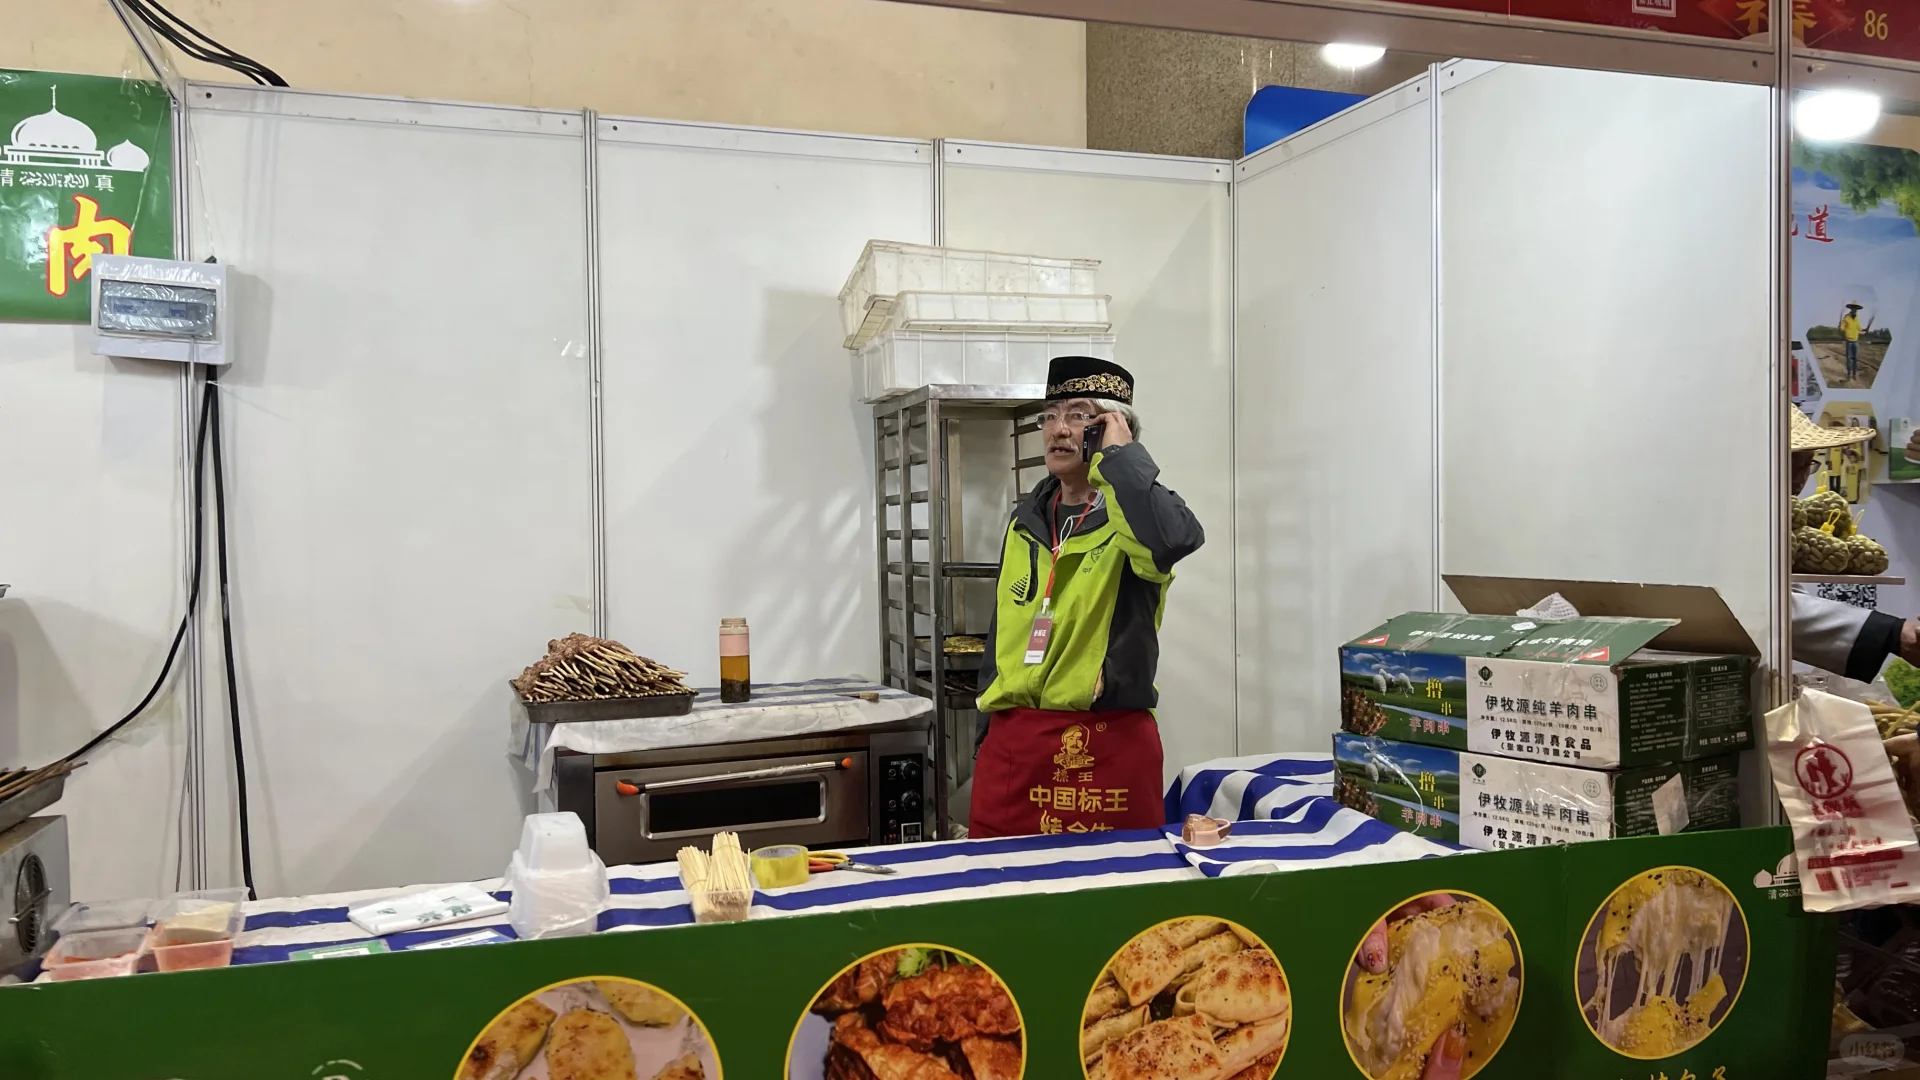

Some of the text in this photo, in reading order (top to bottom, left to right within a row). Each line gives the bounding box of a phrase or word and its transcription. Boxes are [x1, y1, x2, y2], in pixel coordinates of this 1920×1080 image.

[1864, 9, 1889, 41] 86
[95, 174, 115, 193] 真
[47, 194, 132, 297] 肉
[1485, 694, 1598, 721] 伊牧源纯羊肉串
[1409, 716, 1450, 735] 羊肉串
[1491, 728, 1592, 751] 伊牧源清真食品
[1029, 784, 1129, 813] 中国标王
[1478, 791, 1590, 826] 伊牧源纯羊肉串
[1401, 807, 1442, 829] 羊肉串
